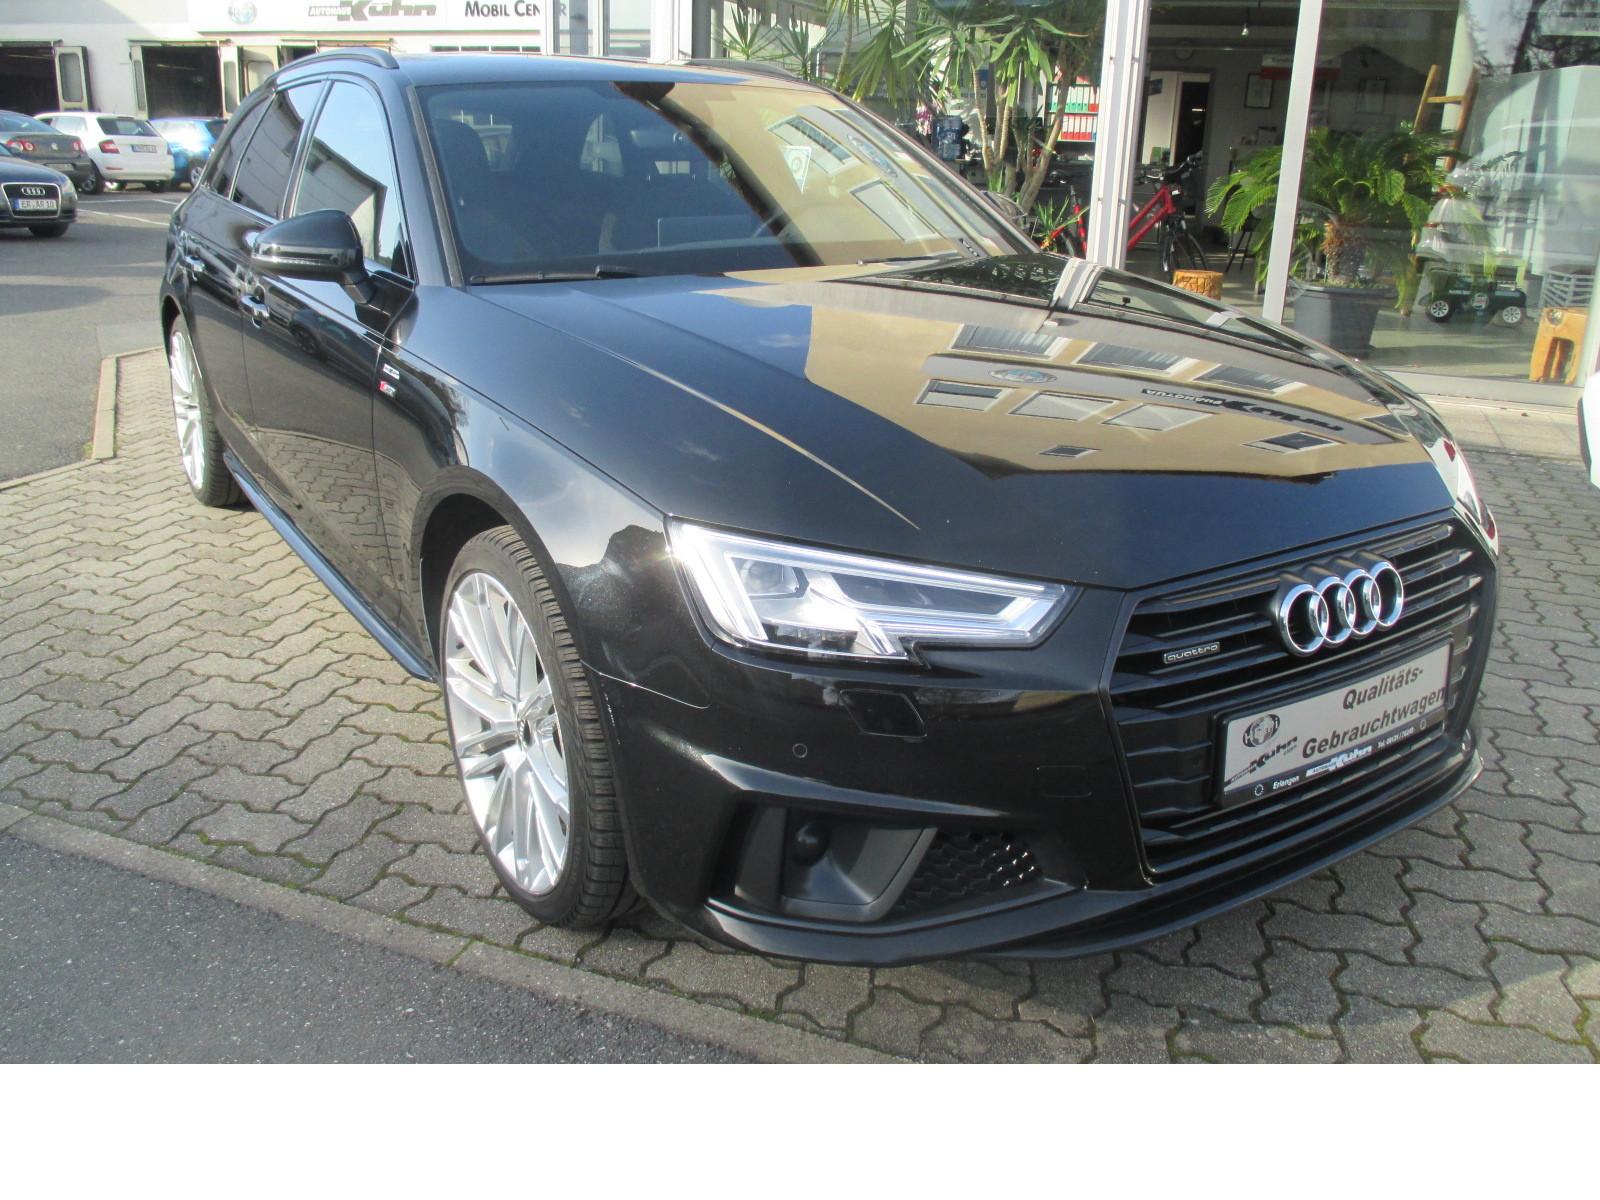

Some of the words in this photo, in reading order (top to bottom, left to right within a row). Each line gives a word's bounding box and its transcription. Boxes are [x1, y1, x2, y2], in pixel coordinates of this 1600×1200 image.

[1167, 644, 1218, 662] quattro
[1343, 665, 1424, 710] Qualitäts-
[1302, 686, 1447, 759] Gebrauchtwagen
[1272, 775, 1300, 790] Erlangen
